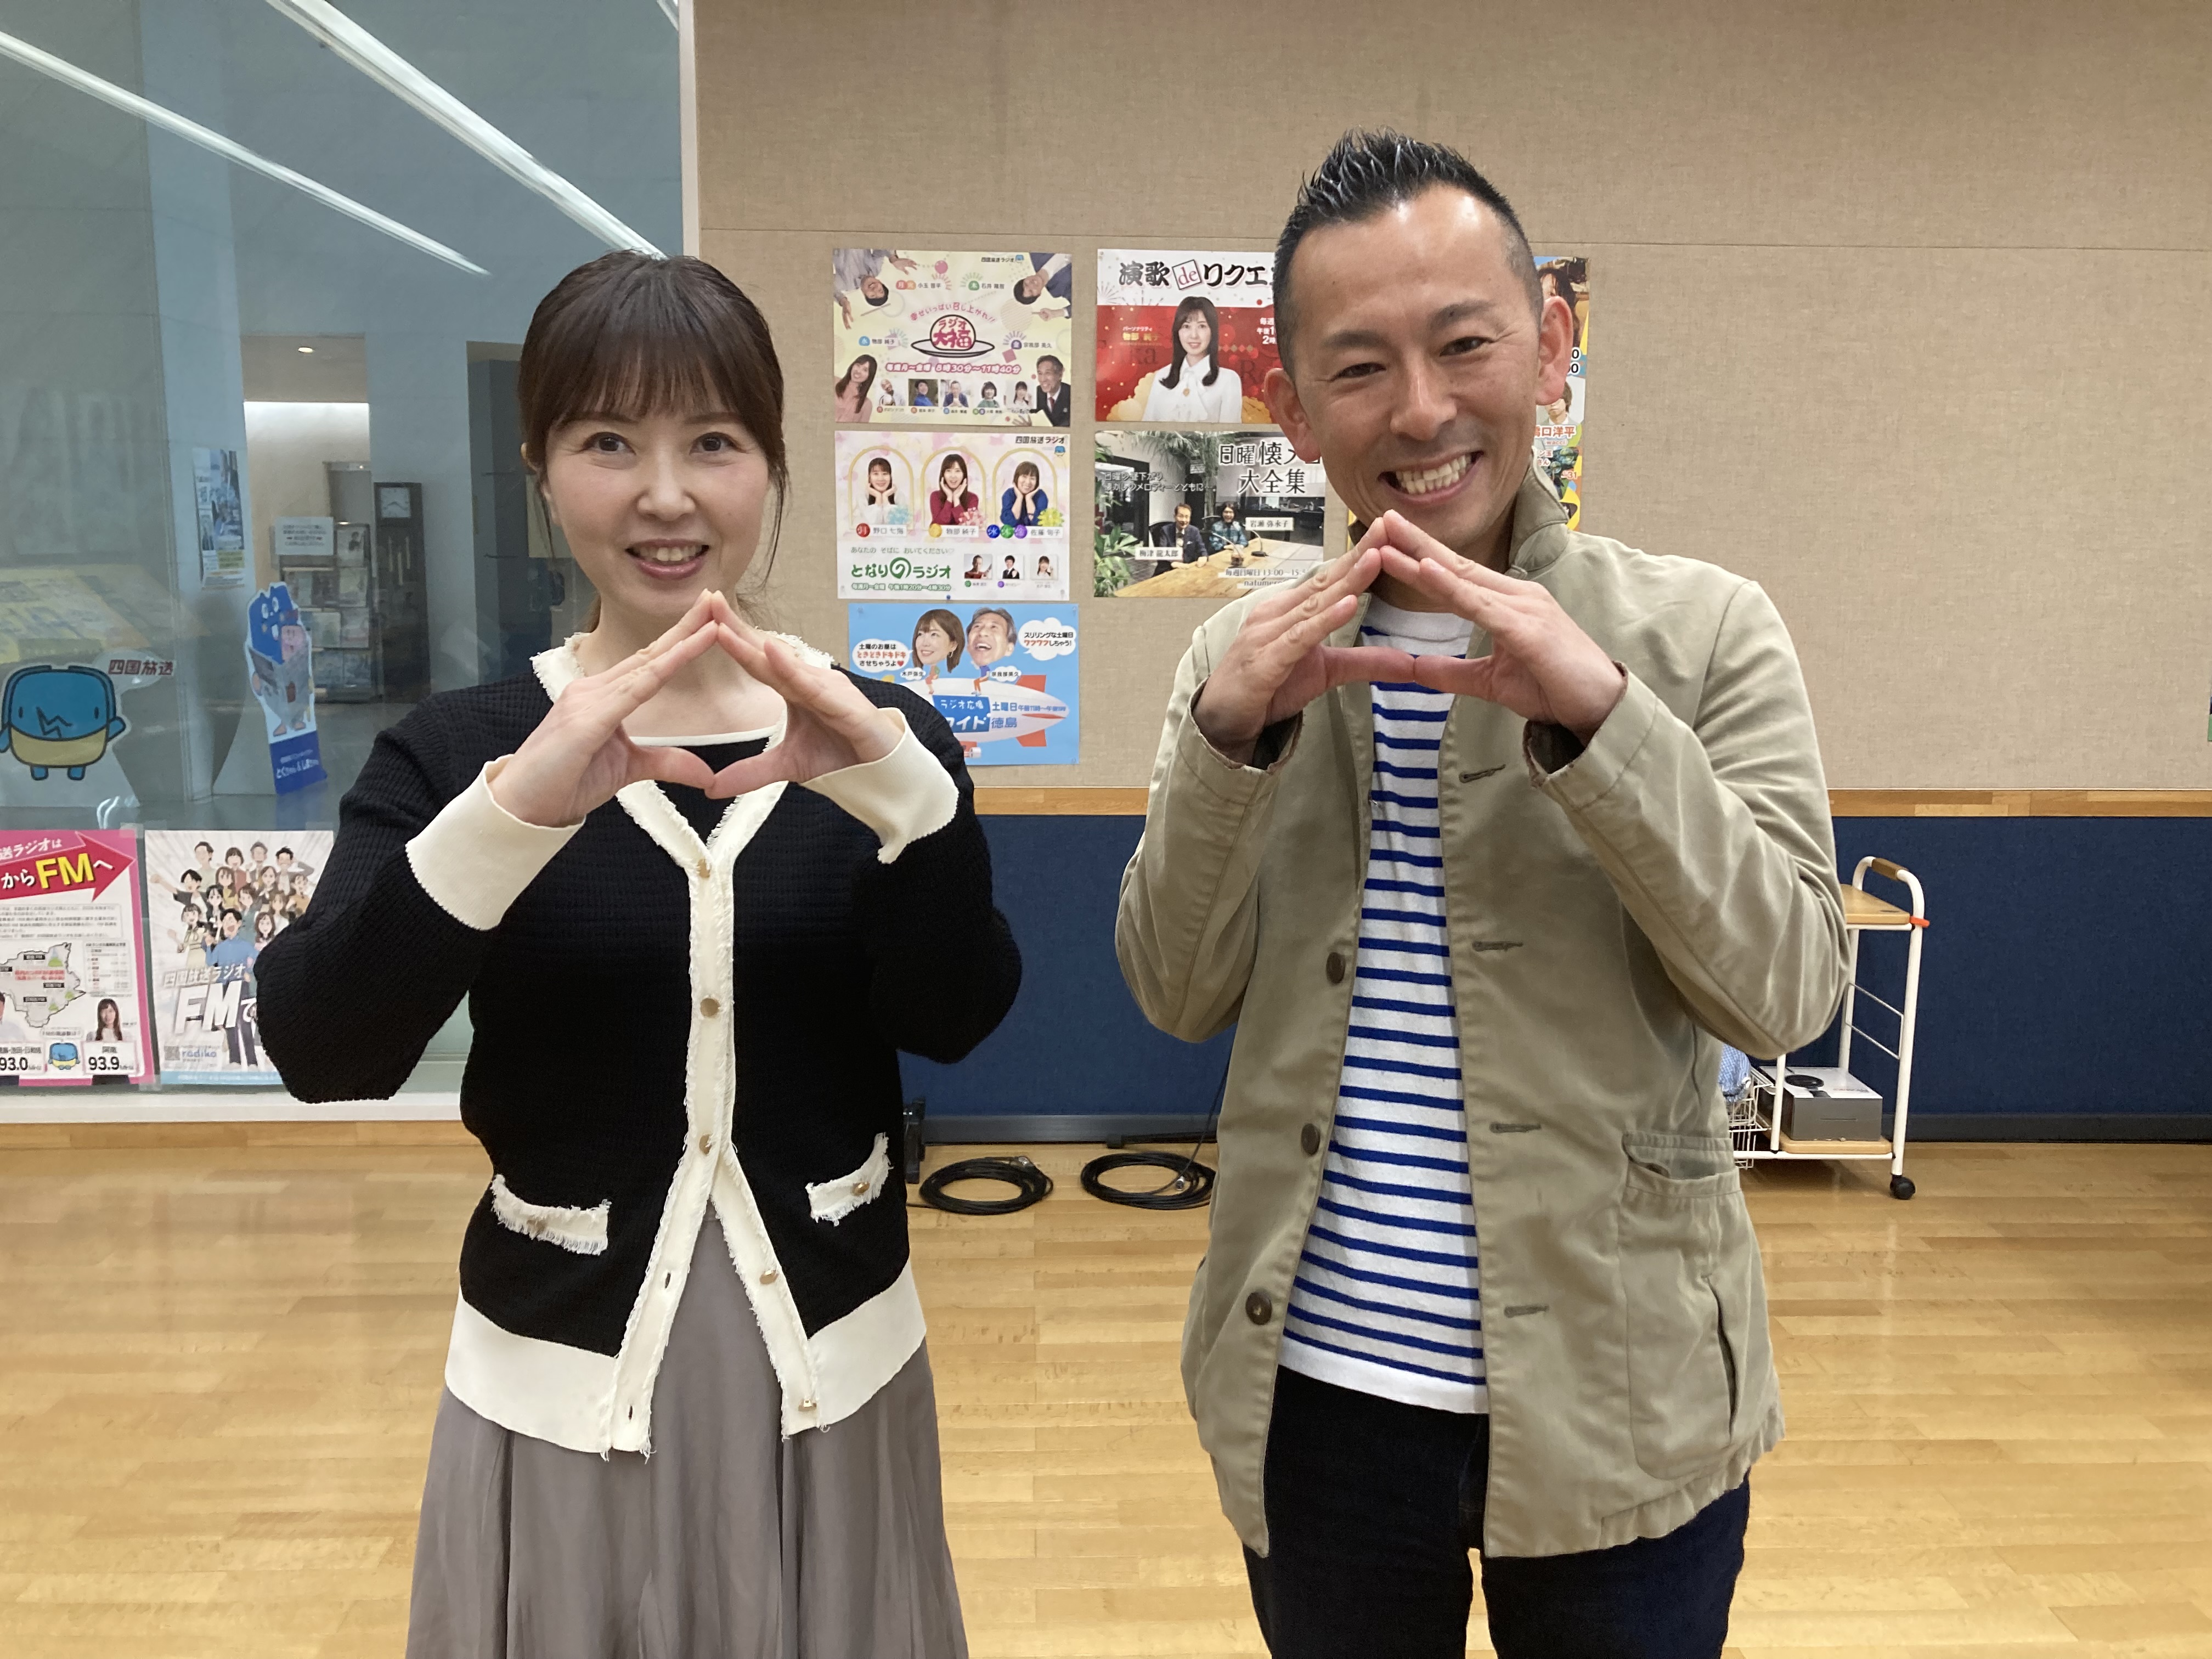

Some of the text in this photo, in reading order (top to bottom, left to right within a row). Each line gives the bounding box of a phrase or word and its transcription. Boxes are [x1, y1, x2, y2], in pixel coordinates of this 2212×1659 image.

[939, 318, 967, 330] ラジオ
[933, 329, 972, 348] 大福
[1015, 436, 1065, 444] 四国放送ラジオ
[1238, 469, 1306, 494] 大全集
[851, 557, 951, 579] となりのラジオ
[108, 659, 173, 675] 四国放送
[940, 699, 984, 710] ラジオ広場
[992, 702, 1018, 712] 土曜日
[991, 717, 1018, 729] 徳島
[88, 1056, 120, 1070] 93.9
